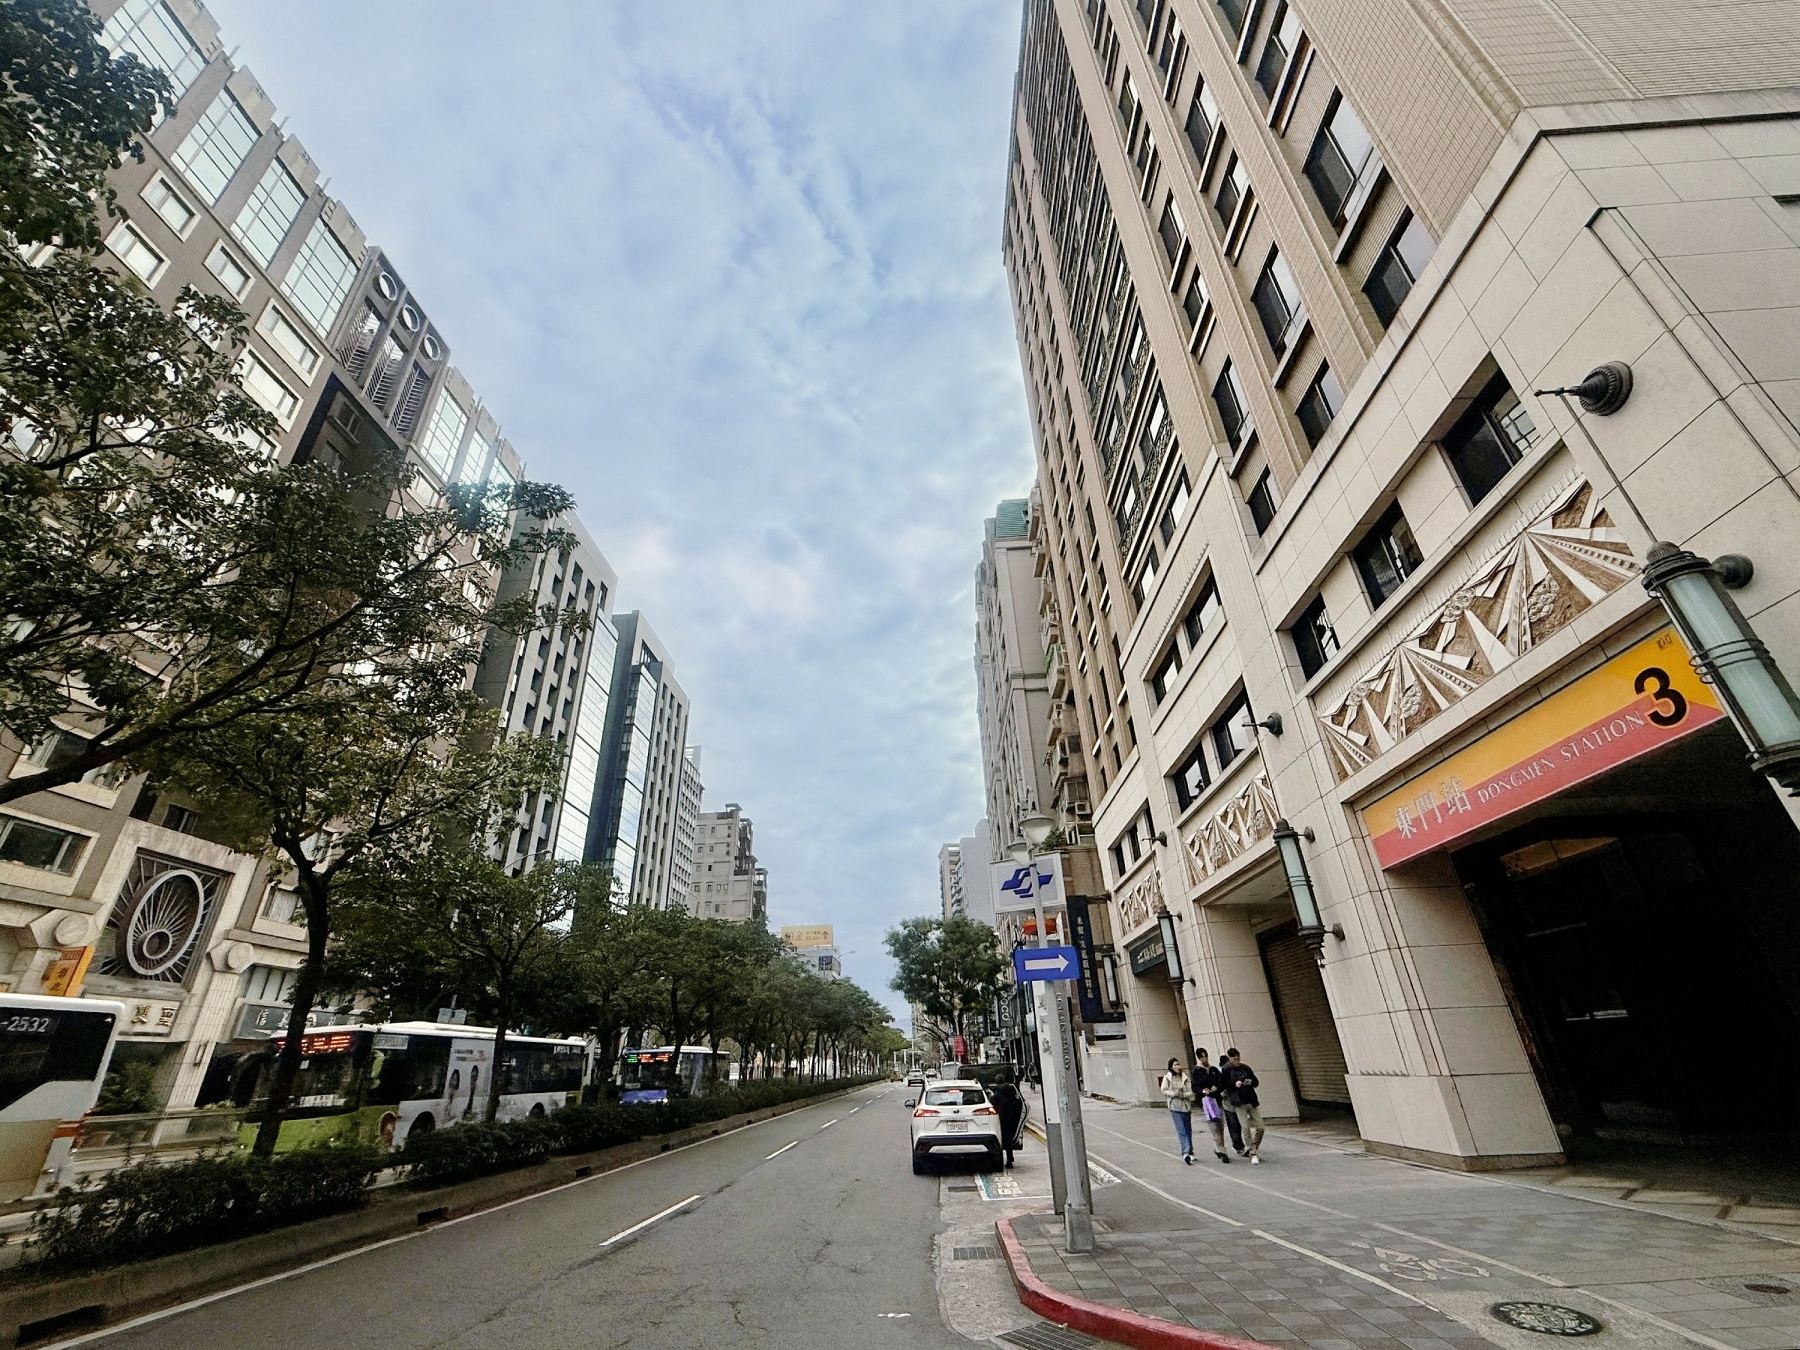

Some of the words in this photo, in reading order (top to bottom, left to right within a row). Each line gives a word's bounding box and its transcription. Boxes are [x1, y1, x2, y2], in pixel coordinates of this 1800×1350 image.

[1634, 667, 1687, 726] 3
[1477, 755, 1556, 804] DONGMEN
[1560, 710, 1645, 763] STATION
[1393, 776, 1472, 839] 東門站
[1055, 992, 1067, 1032] DONGMEN
